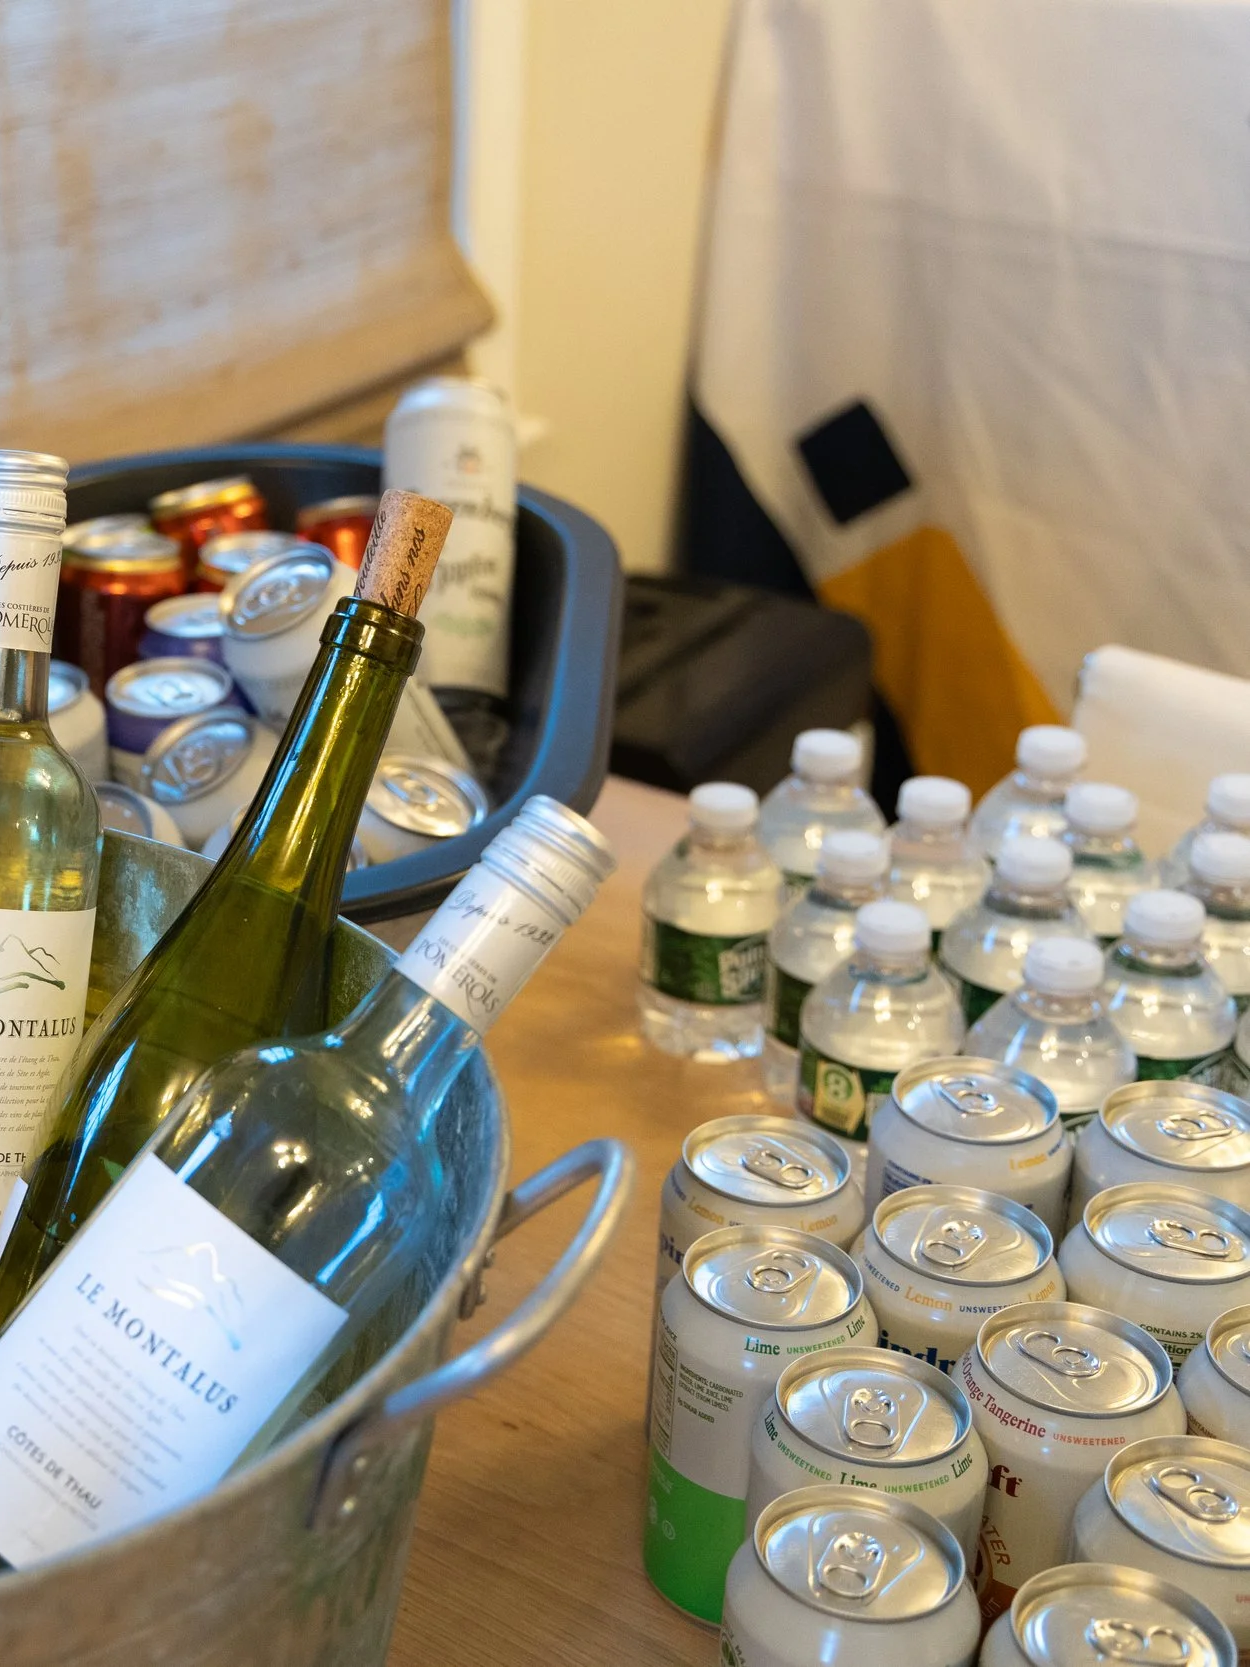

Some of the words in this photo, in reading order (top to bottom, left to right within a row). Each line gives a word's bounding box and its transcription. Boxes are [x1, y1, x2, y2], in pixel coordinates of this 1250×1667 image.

[407, 527, 426, 567] nos
[6, 602, 42, 613] COSTIÈRES
[0, 1082, 7, 1090] de
[24, 1098, 40, 1106] pour
[23, 1110, 30, 1118] de
[14, 1152, 26, 1162] TH
[687, 1194, 725, 1226] Lemon
[801, 1214, 838, 1232] Lemon
[904, 1286, 953, 1312] Lemon
[1028, 1280, 1056, 1302] Lemon
[76, 1272, 105, 1305] LE
[102, 1297, 239, 1415] MONTALUS
[744, 1336, 780, 1356] Lime
[786, 1335, 846, 1354] UNSWEETENED
[846, 1315, 866, 1338] Lime
[1139, 1323, 1188, 1338] CONTAINS
[1190, 1331, 1204, 1339] 2%
[710, 1380, 744, 1398] CARBONATED
[720, 1394, 733, 1404] LIME
[962, 1361, 984, 1401] Orange
[983, 1394, 1046, 1438] Tangerine
[1052, 1432, 1126, 1446] UNSWEETENED
[764, 1411, 778, 1441] Lime
[777, 1440, 832, 1481] UNSWEETENED
[884, 1474, 950, 1494] UNSWEETENED
[950, 1452, 974, 1480] Lime
[43, 1460, 64, 1480] DE
[64, 1474, 102, 1510] THAU
[980, 1514, 1011, 1566] ATER
